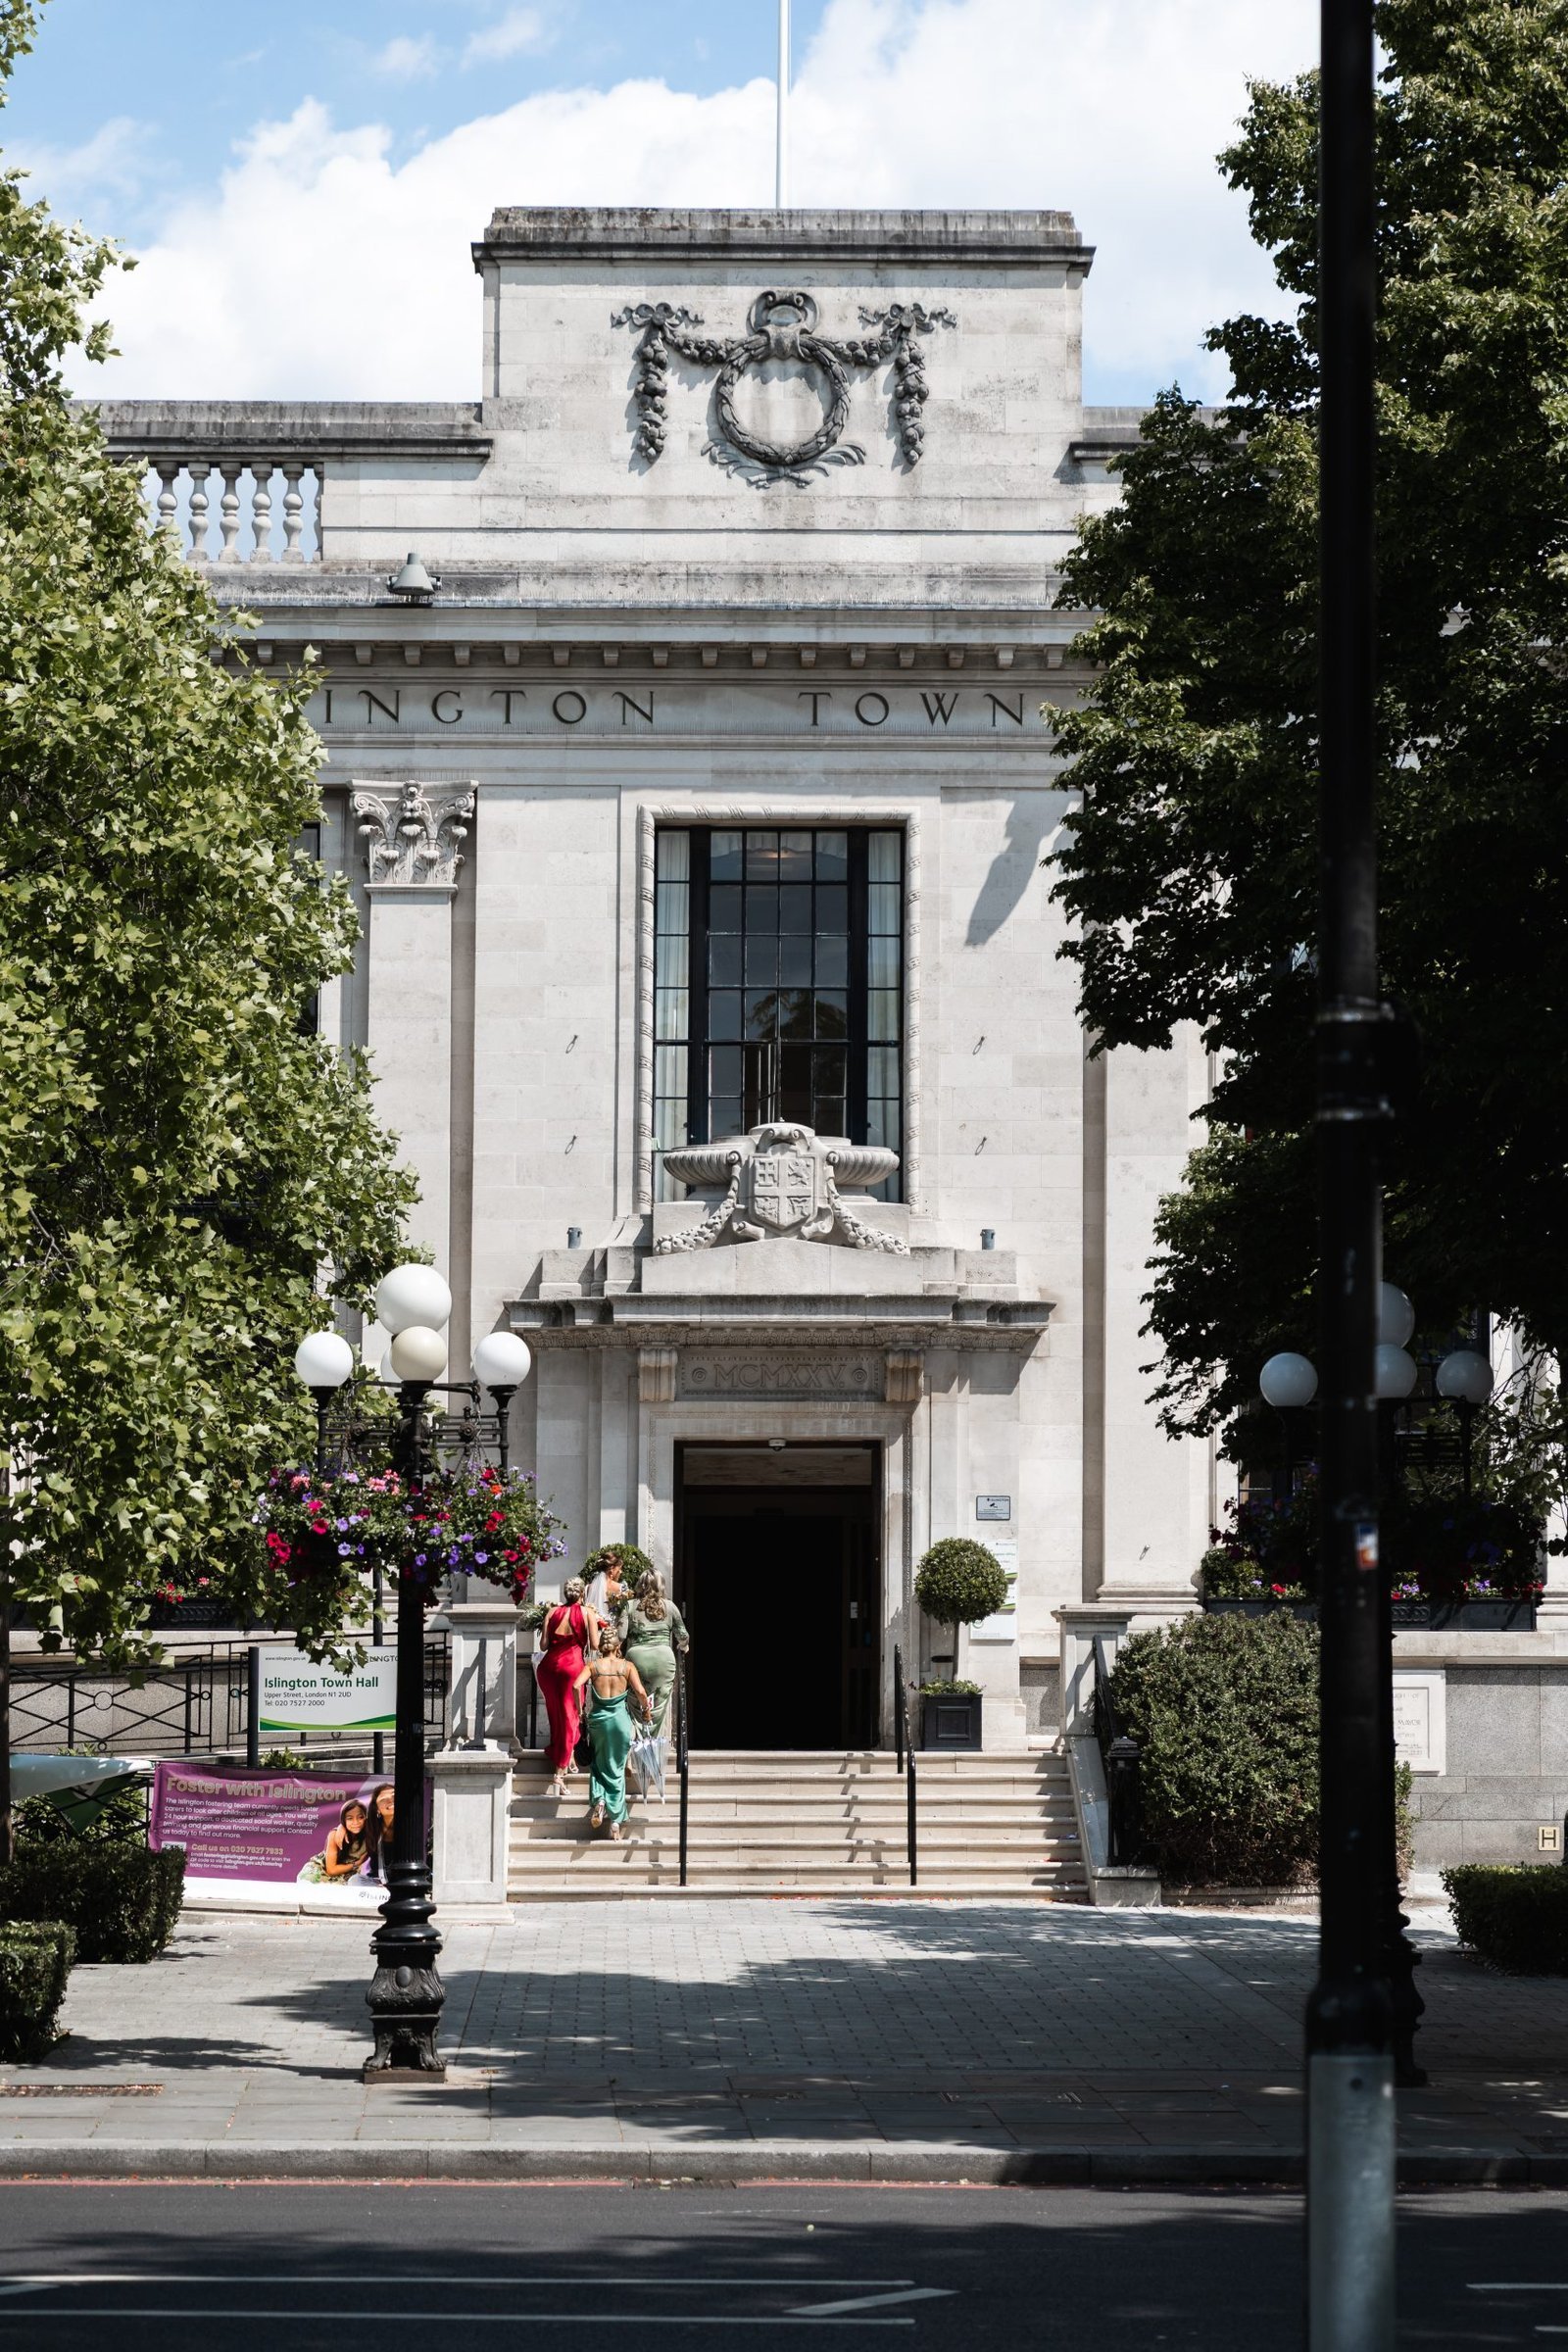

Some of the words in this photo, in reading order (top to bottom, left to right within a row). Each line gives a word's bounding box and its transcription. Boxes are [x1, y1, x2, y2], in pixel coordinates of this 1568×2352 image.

[325, 689, 655, 725] INGTON
[798, 692, 1024, 726] TOWN
[713, 1363, 848, 1389] MCMXXV.
[265, 1677, 317, 1690] Islington
[320, 1677, 352, 1688] Town
[356, 1676, 378, 1688] Hall
[167, 1777, 221, 1794] Foster
[225, 1782, 265, 1797] with
[269, 1784, 346, 1804] Islington
[206, 1800, 233, 1809] fostering
[1542, 1829, 1556, 1848] H
